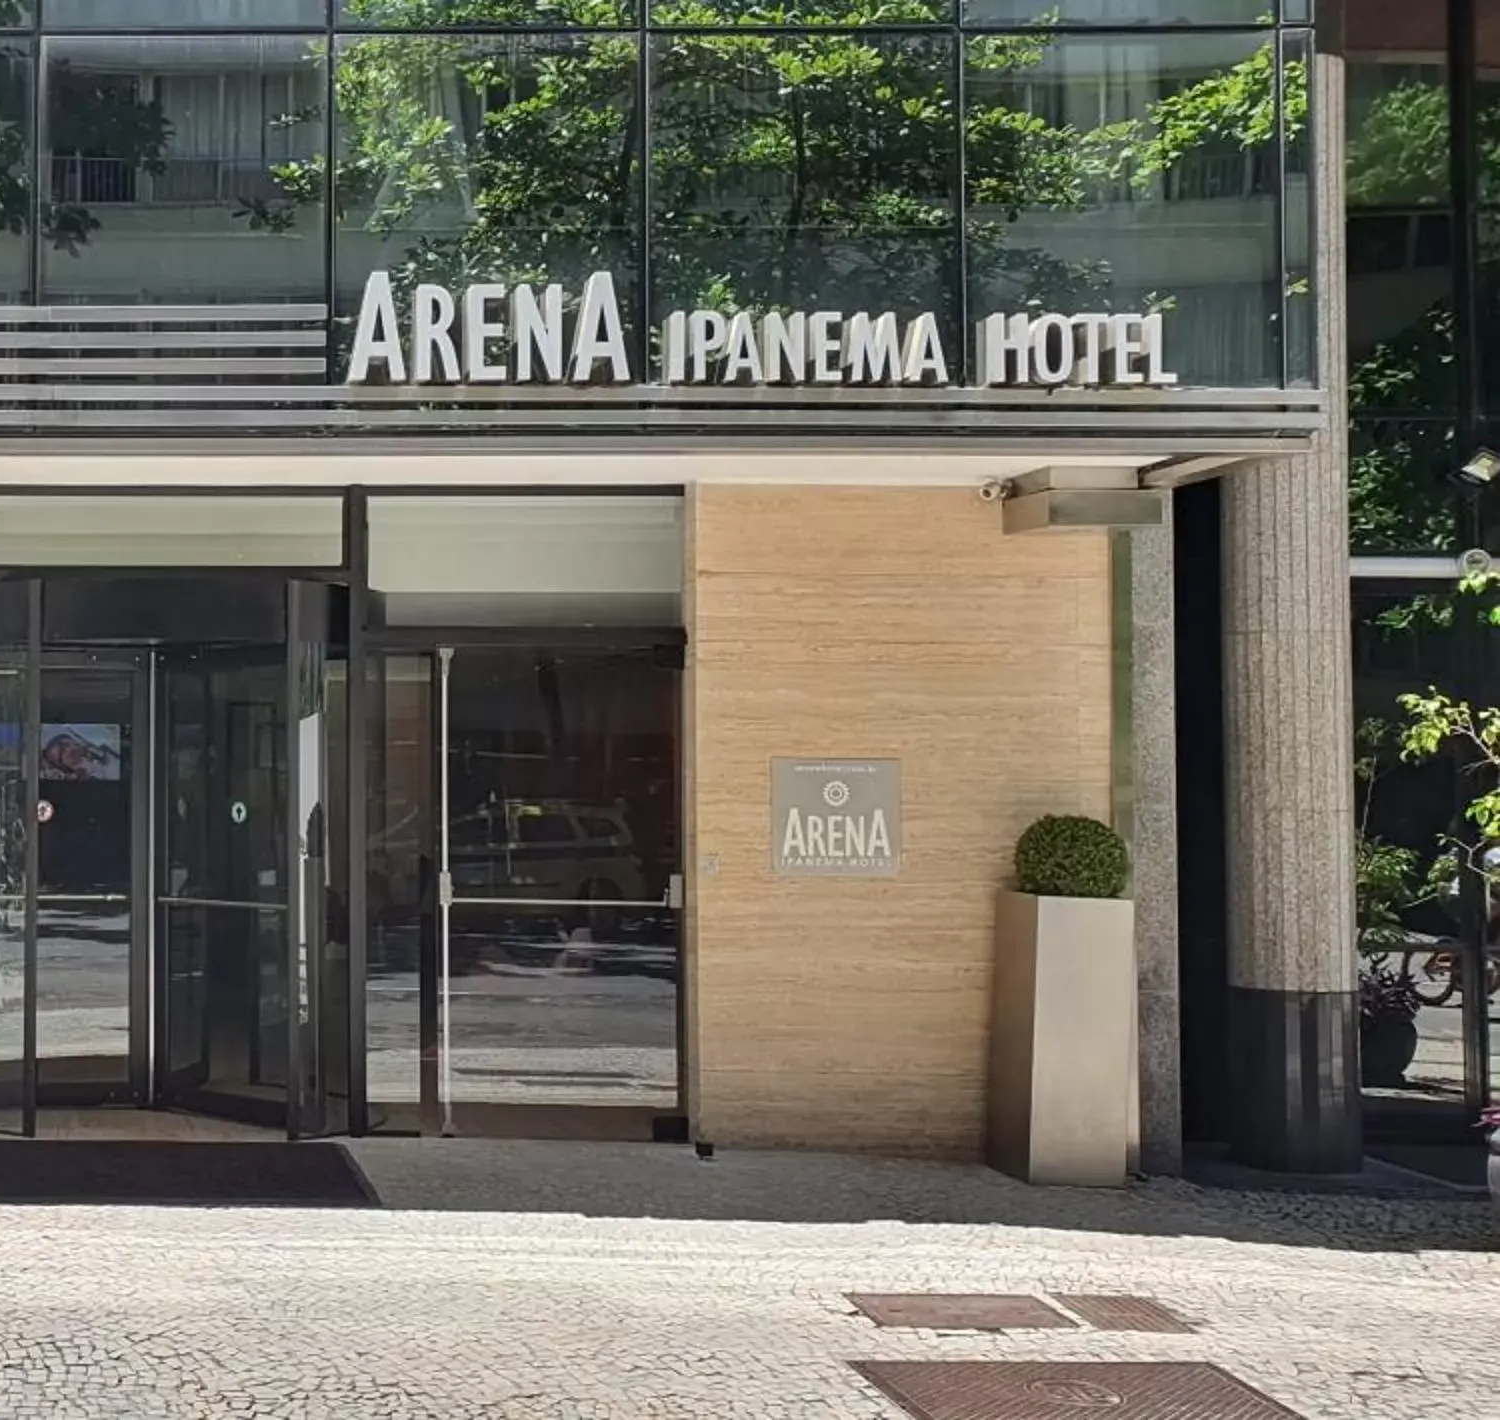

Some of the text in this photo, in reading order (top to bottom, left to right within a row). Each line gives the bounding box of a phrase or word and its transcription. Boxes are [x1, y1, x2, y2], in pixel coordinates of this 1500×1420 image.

[347, 271, 1178, 385] ARENA IPANEMA HOTEL
[783, 807, 892, 857] ARENA
